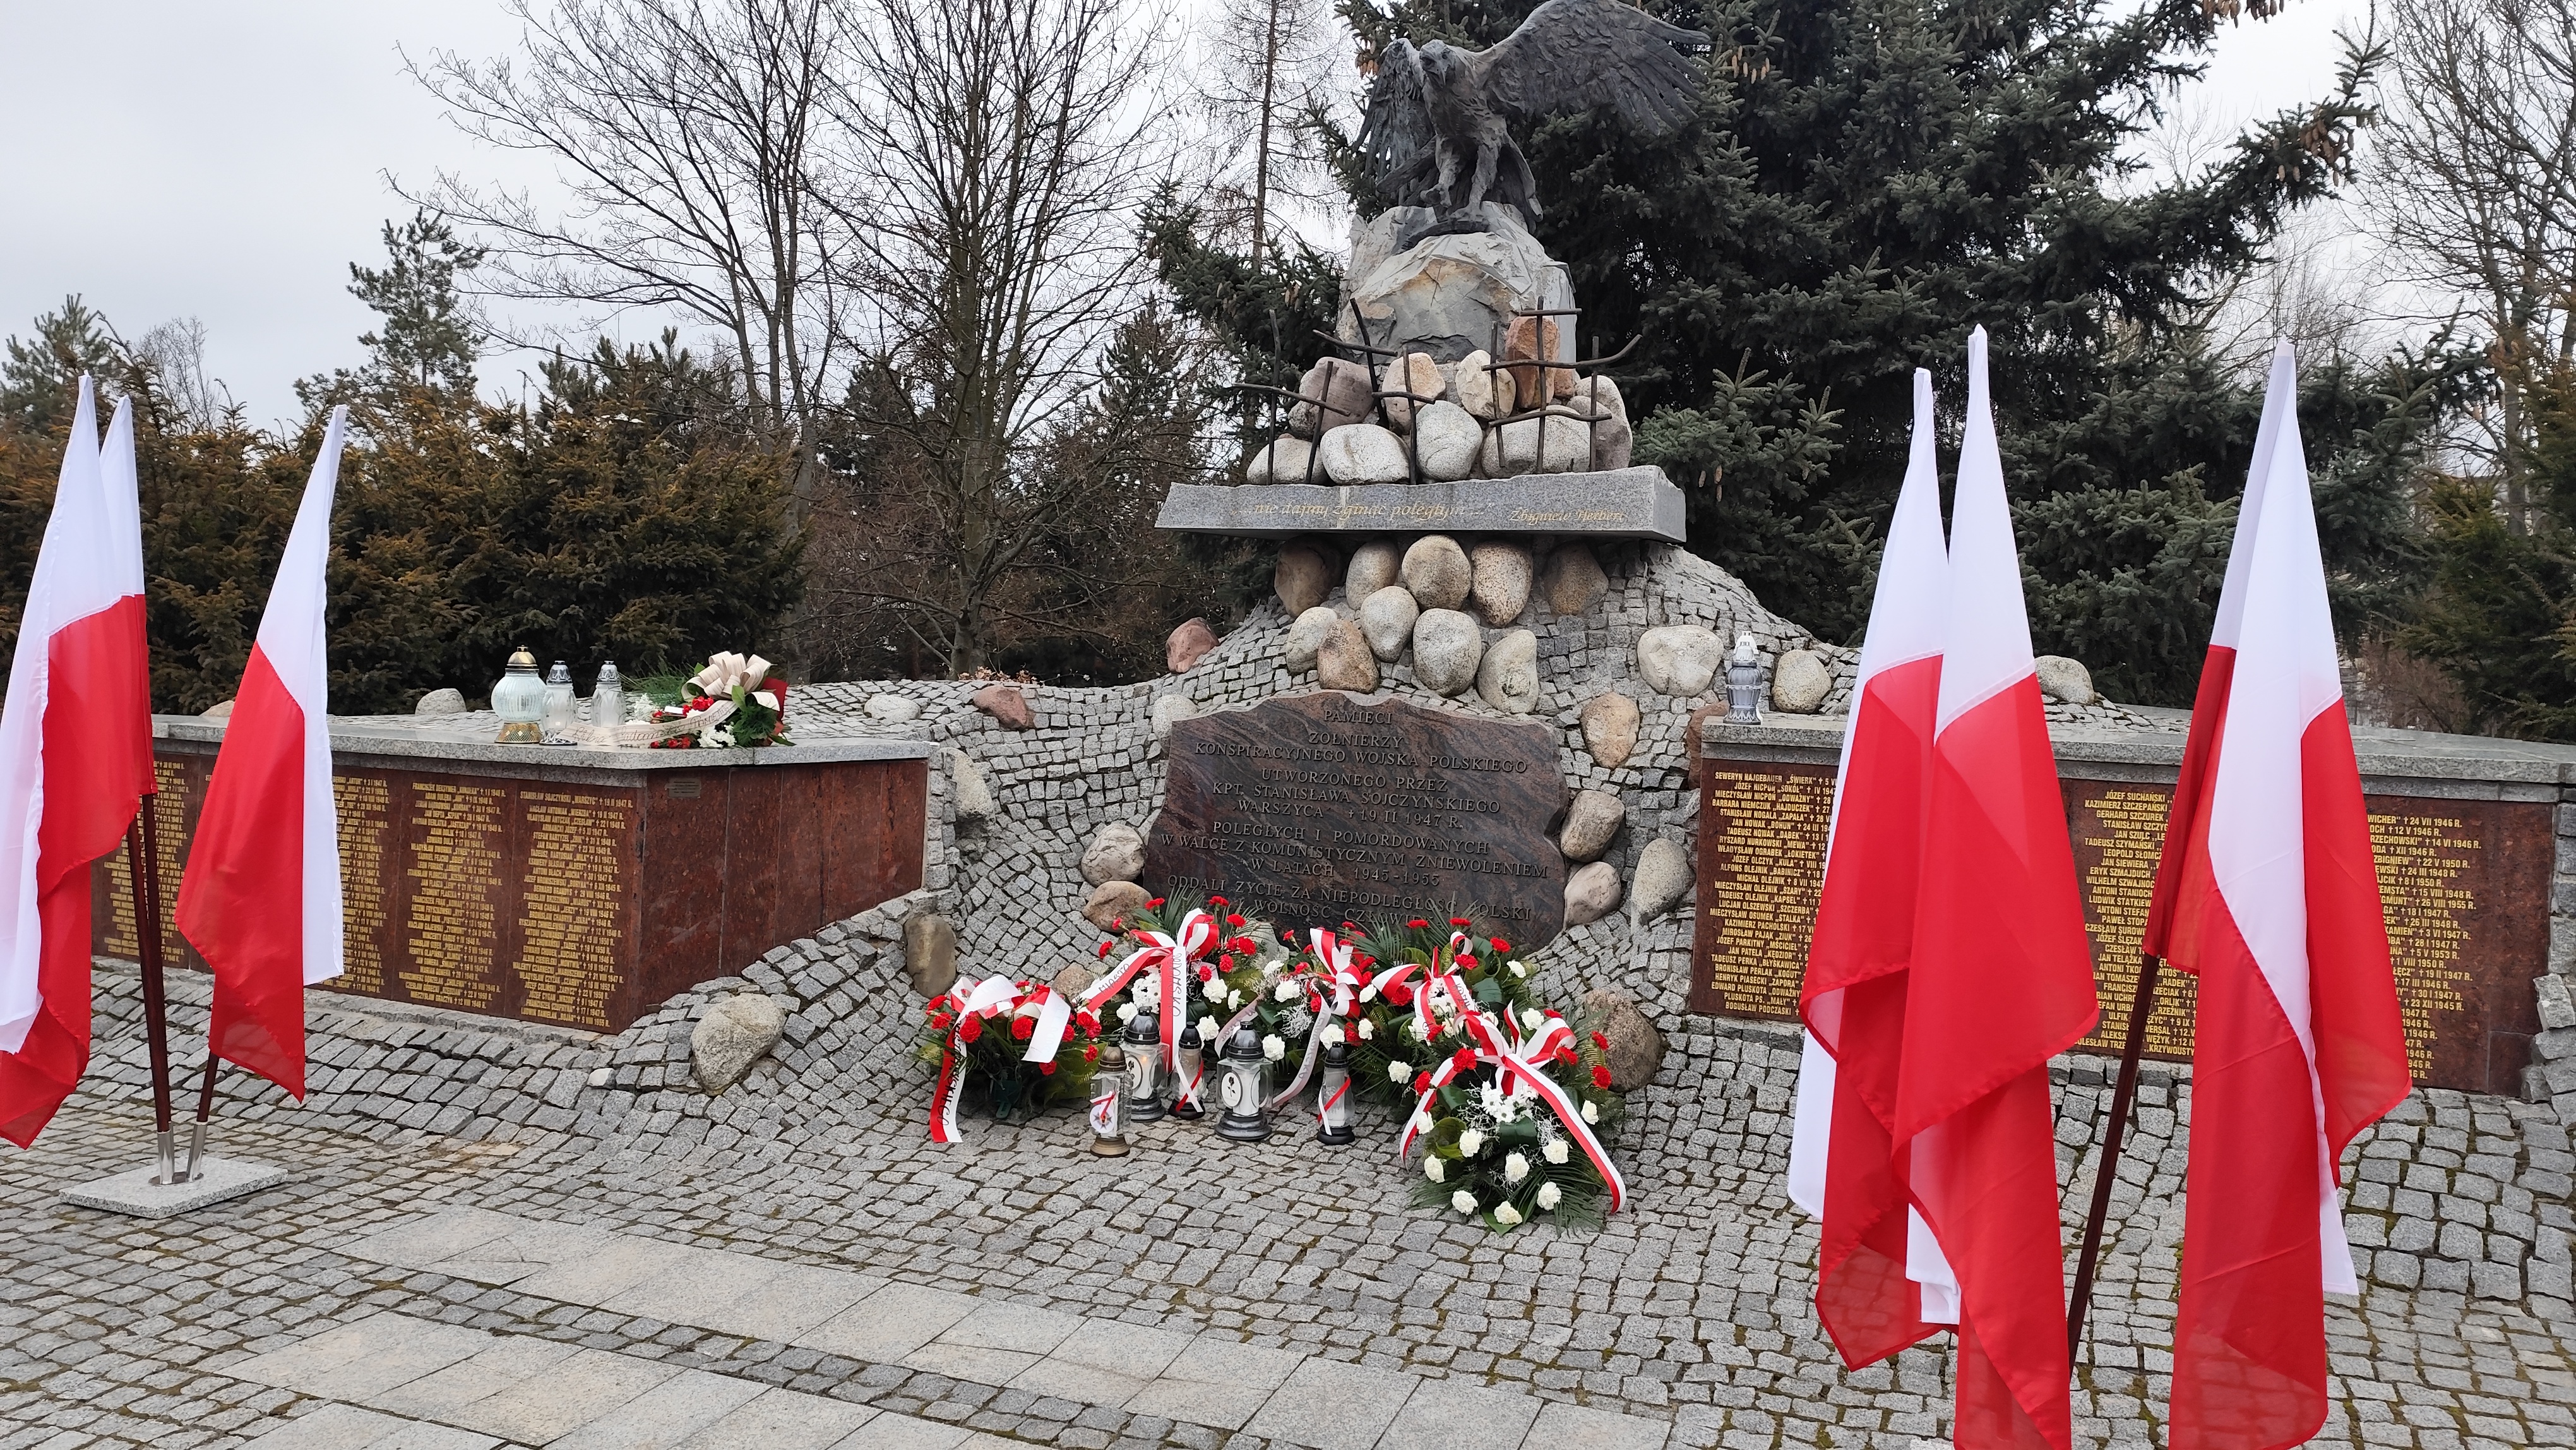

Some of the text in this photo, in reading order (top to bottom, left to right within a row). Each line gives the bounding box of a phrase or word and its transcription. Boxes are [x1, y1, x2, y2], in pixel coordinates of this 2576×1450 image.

[1509, 507, 1626, 525] Zbigniew Herbert
[1324, 710, 1392, 724] PAMIĘCI
[1195, 742, 1527, 773] KONSPIRACYJNEGO WOJSKA POLSKIEGO
[1262, 768, 1448, 791] UTWORZONEGO PRZEZ
[1715, 771, 1743, 781] SEWERYN
[1744, 773, 1782, 783] NAJGEBAUER
[1734, 781, 1752, 789] JÓZEF
[1212, 782, 1500, 813] KPT. STANISŁAWA SOJCZYŃSKIEGO
[2105, 789, 2166, 802] JÓZEF SUCHAŃSKI
[1712, 798, 1739, 808] BARBARA
[1741, 800, 1771, 810] NIEMCZUK
[2084, 800, 2168, 812] KAZIMIERZ SZCZEPAŃSKI
[1361, 809, 1376, 822] 19
[1385, 810, 1397, 823] II
[1405, 813, 1441, 827] 1947
[1448, 815, 1464, 829] R.
[2096, 810, 2164, 821] GERHARD SZCZUREK
[1731, 818, 1743, 826] JAN
[1744, 819, 1766, 827] NOWAK
[2409, 817, 2420, 825] 24
[2421, 817, 2432, 825] VII
[2433, 818, 2453, 827] 1946
[2454, 818, 2463, 827] R.
[1213, 821, 1489, 854] POLEGŁYCH I POMORDOWANYCH
[2114, 830, 2150, 840] JAN SZULC
[1719, 836, 1746, 844] RYSZARD
[1747, 837, 1782, 847] NURKOWSKI
[2084, 838, 2155, 849] TADEUSZ SZYMAŃSKI
[2431, 838, 2442, 846] 14
[2443, 838, 2451, 847] VI
[2453, 839, 2472, 848] 1946
[2473, 840, 2482, 849] R.
[1160, 834, 1547, 878] W WALCE Z KOMUNISTYCZNYM ZNIEWOLENIEM
[1717, 844, 1754, 854] WŁADYSŁAW
[1755, 847, 1783, 856] OGRABEK
[1731, 854, 1750, 863] JÓZEF
[1751, 856, 1774, 865] OLCZYK
[1806, 860, 1817, 868] VIII
[2422, 858, 2433, 866] 22
[2434, 858, 2440, 866] V
[2442, 859, 2460, 868] 1950
[2462, 860, 2471, 868] R.
[1251, 858, 1264, 870] W
[1273, 860, 1335, 877] LATACH
[2089, 867, 2151, 878] ERYK SZMAJDUCH
[1736, 873, 1760, 882] MICHAŁ
[1761, 875, 1786, 885] OLEJNIK
[1799, 878, 1808, 886] VII
[1810, 879, 1824, 888] 1947
[1168, 875, 1225, 891] ODDALI
[1292, 886, 1310, 899] ZA
[2092, 887, 2153, 897] ANTONI STANIOCH
[2378, 885, 2474, 899] EMSTA” 15 VIII 1948 R.
[1254, 899, 1331, 918] WOLNOŚĆ
[1719, 900, 1741, 908] LUCJAN
[1742, 901, 1775, 911] OLSZEWSKI
[1720, 928, 1753, 938] MIROSŁAW
[1755, 930, 1774, 940] PAJĄK
[1804, 934, 1812, 942] 26
[1741, 947, 1763, 957] PATELA
[2396, 957, 2447, 968] 1 VIII 1950 R.
[1715, 973, 1738, 982] HENRYK
[1739, 974, 1767, 985] PIASECKI
[1725, 1002, 1791, 1015] BOGUSŁAW PODCZASKI
